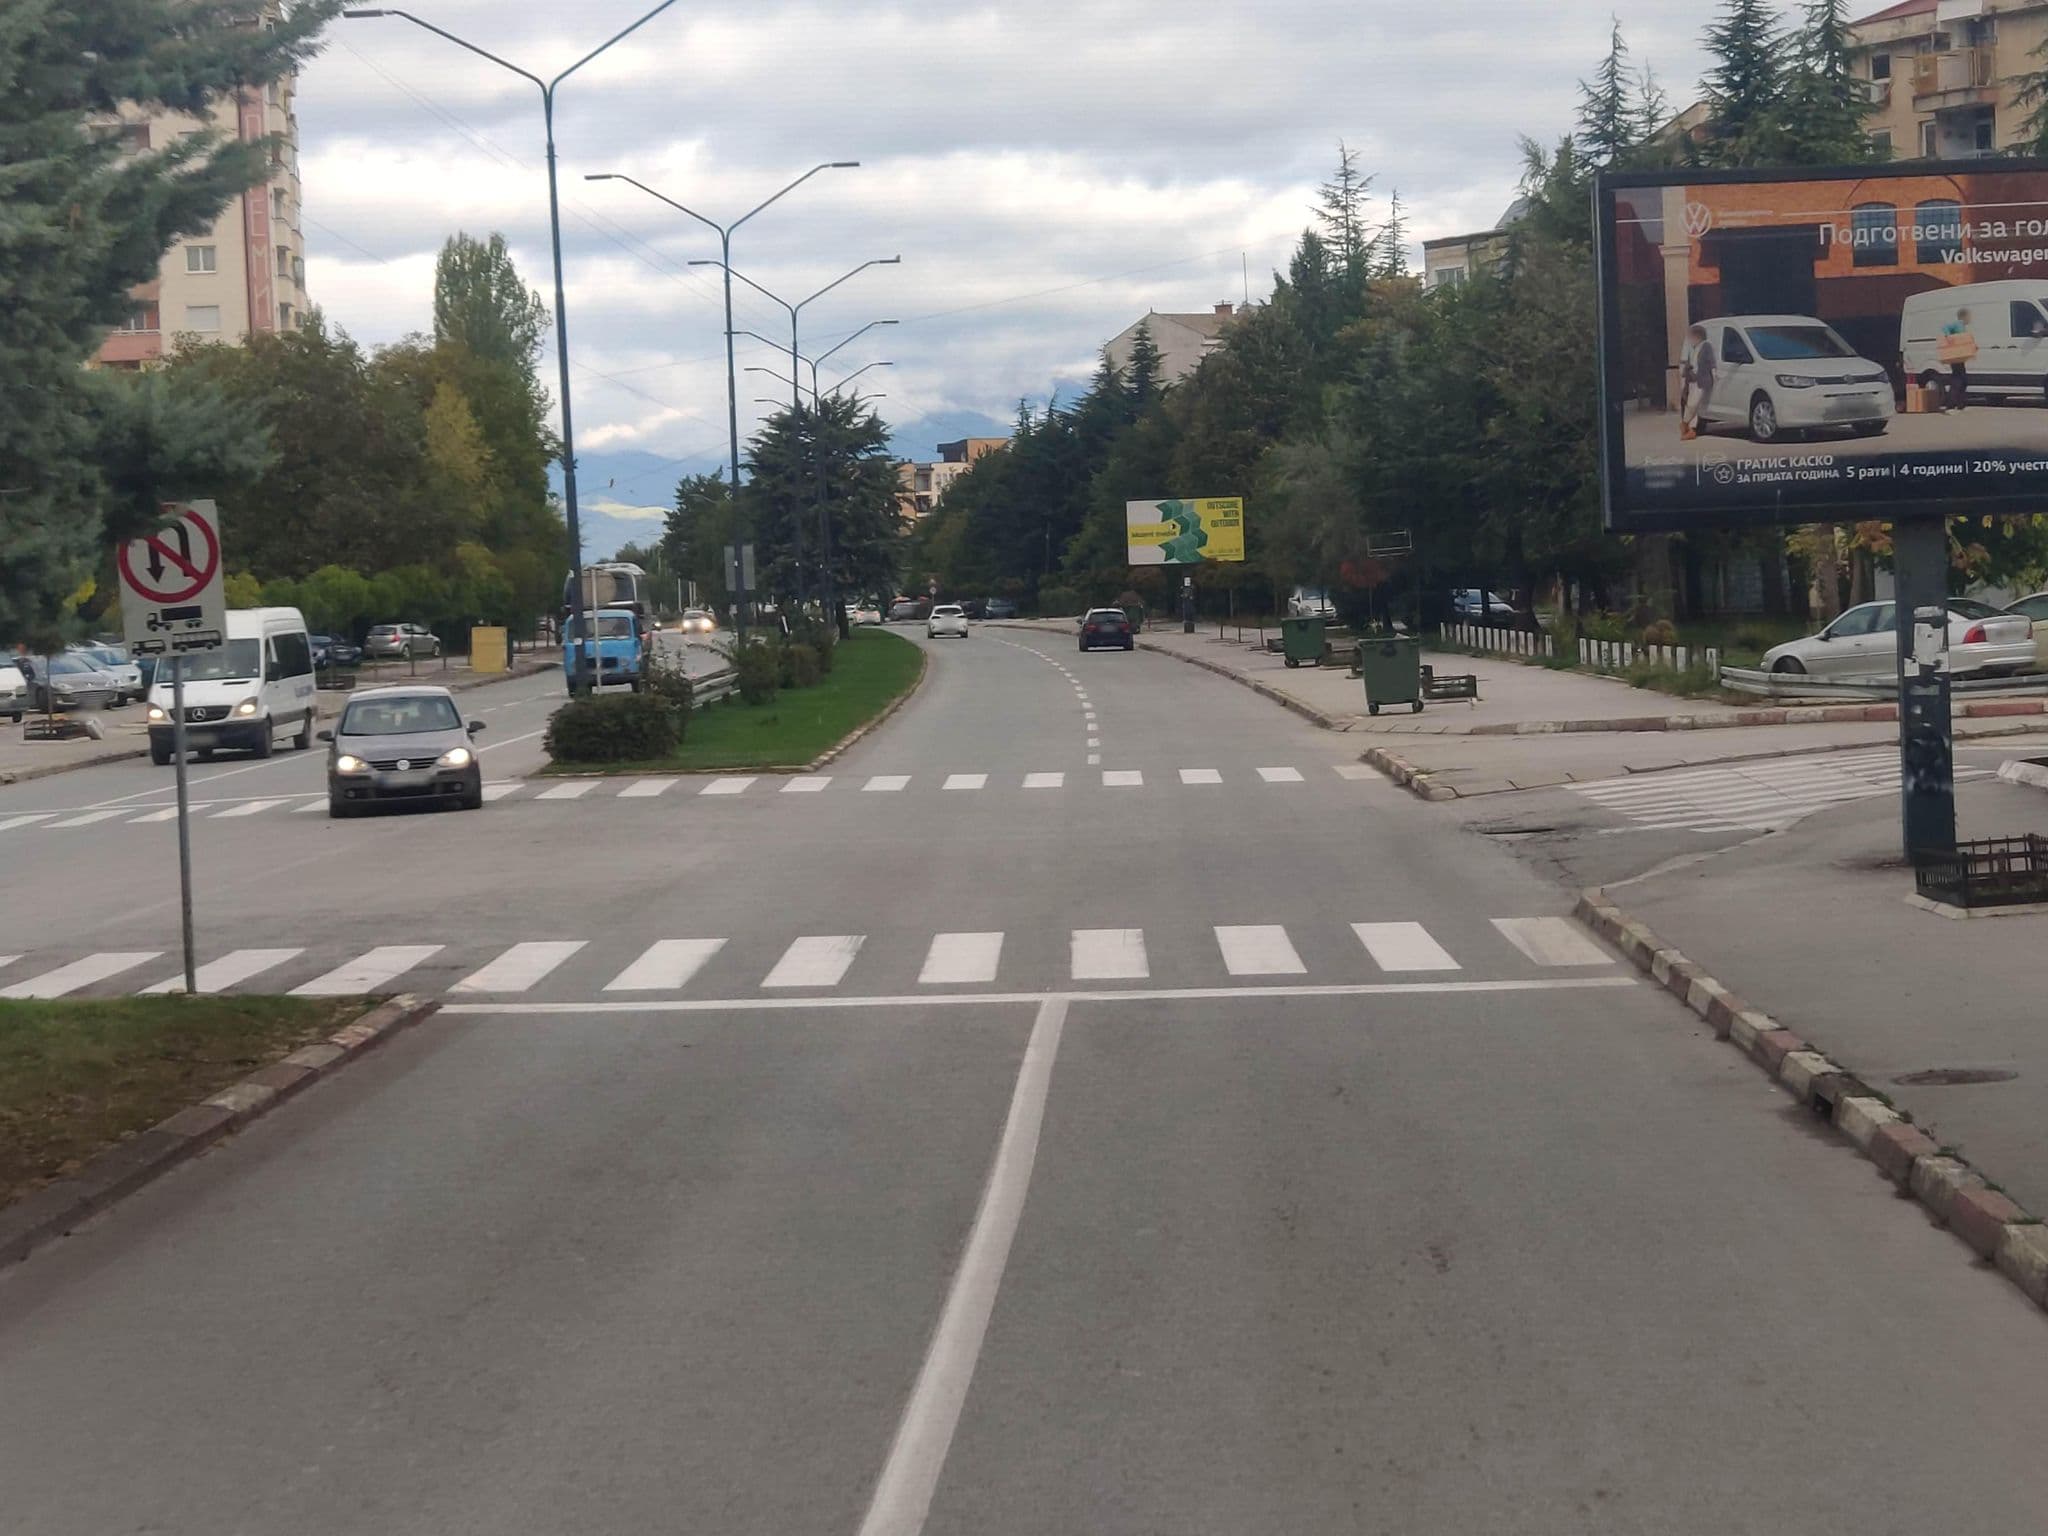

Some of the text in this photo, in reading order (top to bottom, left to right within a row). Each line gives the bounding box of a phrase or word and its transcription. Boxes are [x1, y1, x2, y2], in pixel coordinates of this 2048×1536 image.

[1819, 222, 1971, 247] Подготвени
[1979, 221, 2008, 238] за
[1737, 455, 1833, 471] ГРАТИС КАСКО
[1846, 460, 2048, 480] 5 рати 4 години 20% учест
[1737, 469, 1840, 484] ЗА ПРВАТА ГОДИНА
